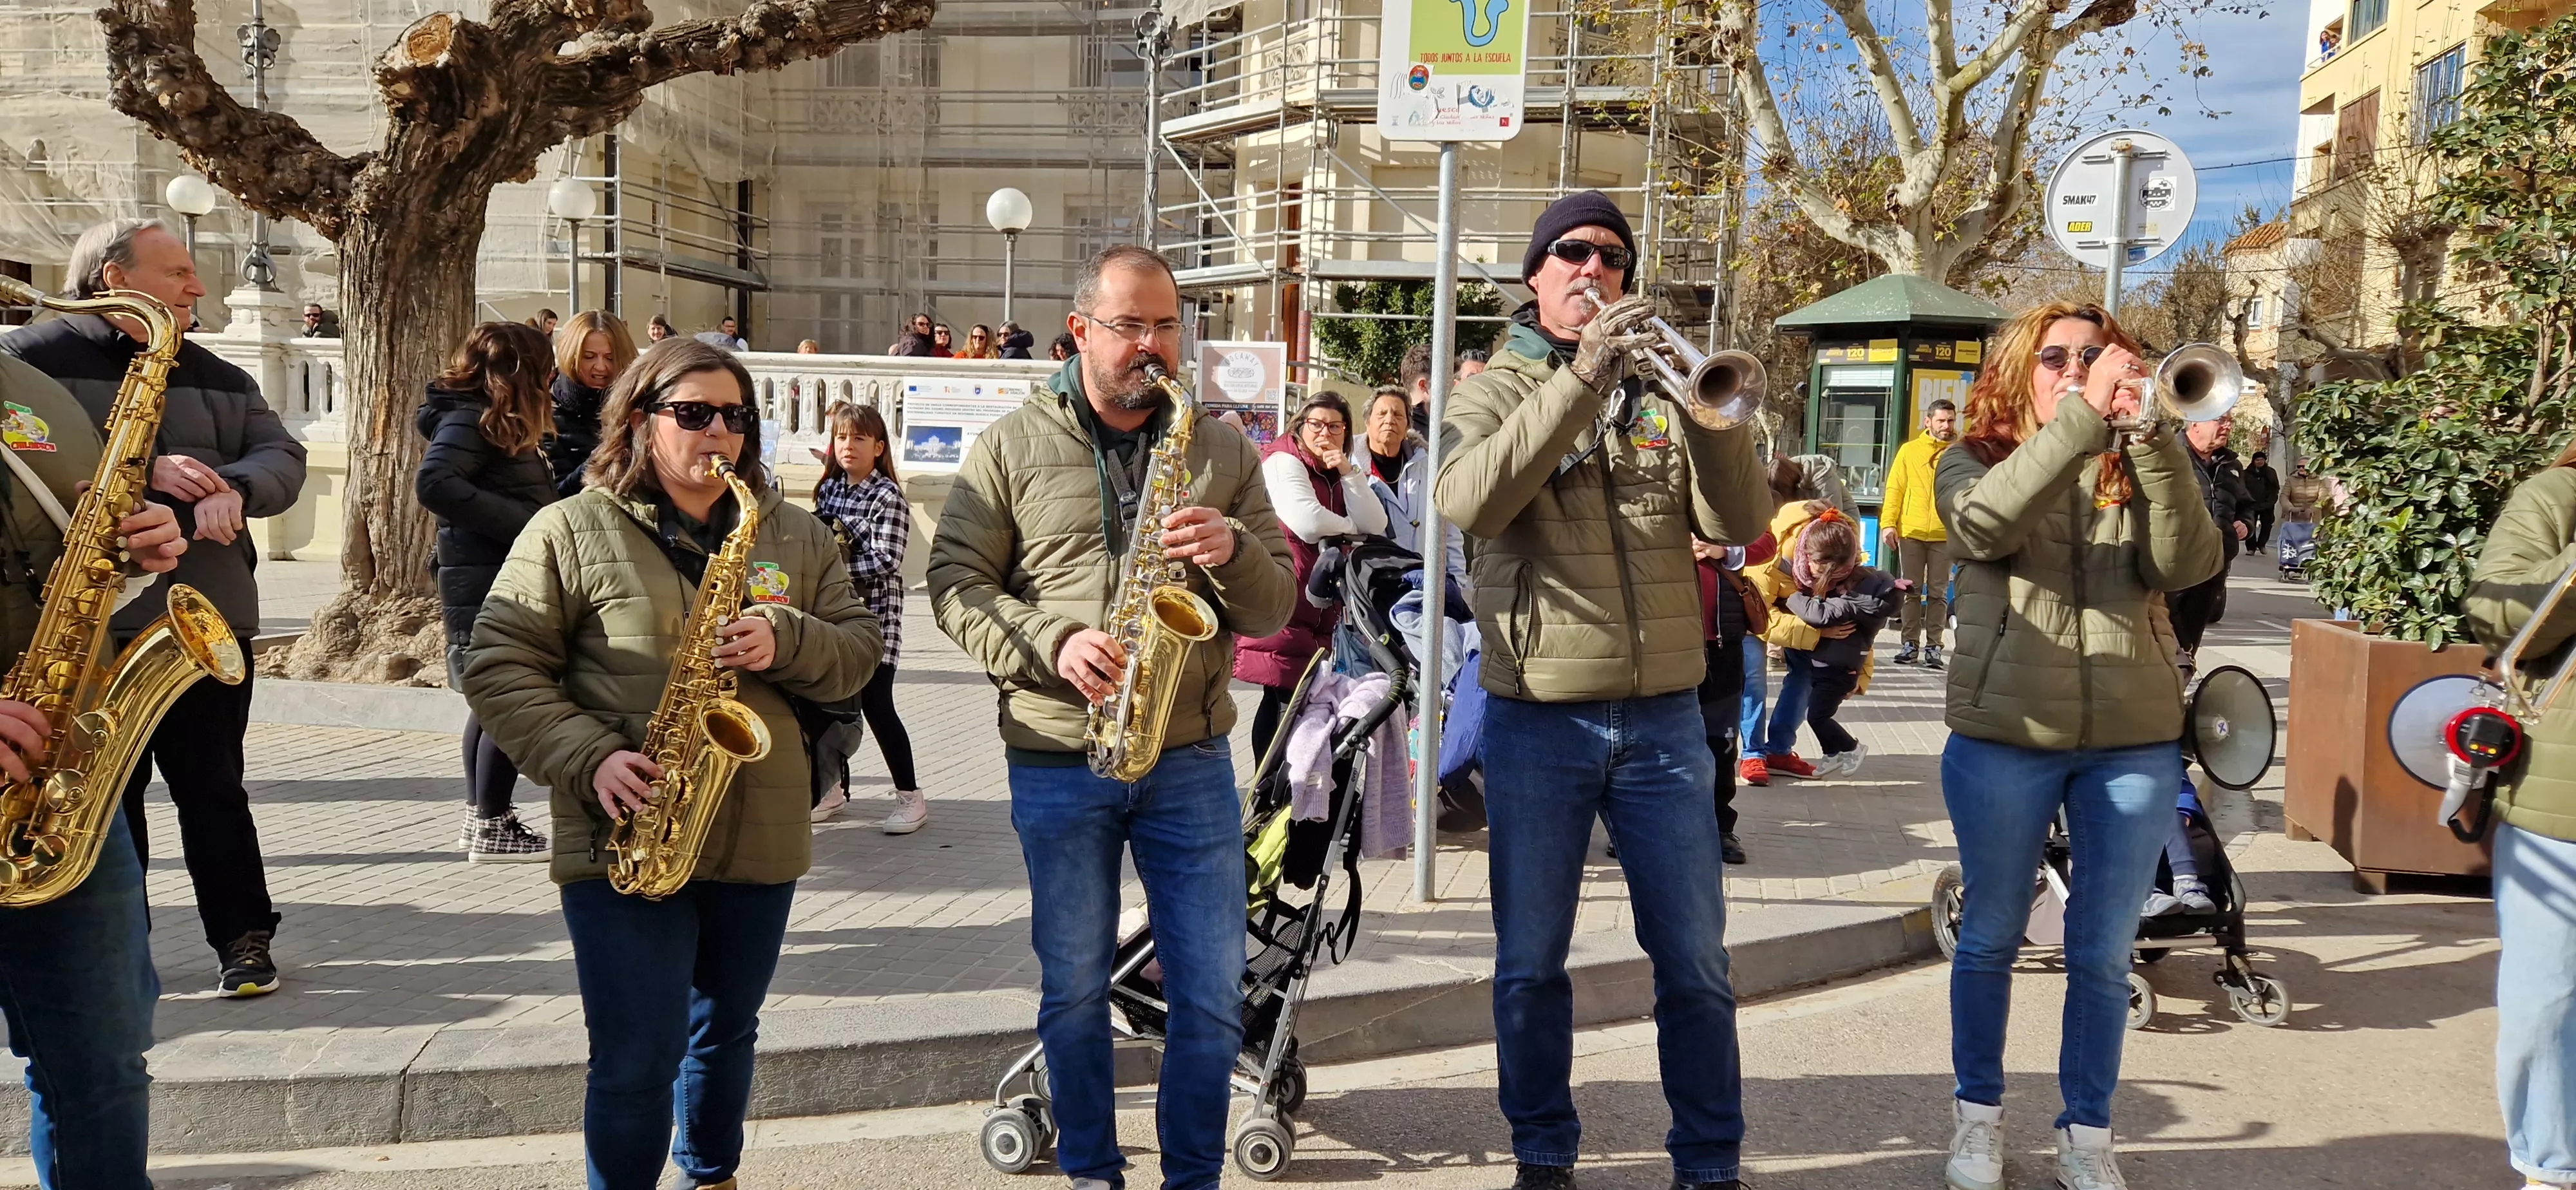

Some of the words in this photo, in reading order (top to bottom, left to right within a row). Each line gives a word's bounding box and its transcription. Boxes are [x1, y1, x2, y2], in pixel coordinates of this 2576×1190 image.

[1420, 53, 1438, 62] TODOS
[1441, 53, 1463, 62] JUNTOS
[1465, 53, 1470, 62] A
[1473, 53, 1482, 62] LA
[1485, 53, 1511, 62] ESCUELA
[2062, 194, 2097, 205] SMAK47
[2068, 222, 2092, 232] ADER
[1846, 348, 1864, 357] 120
[1935, 346, 1951, 357] 120
[1918, 378, 1967, 412] BIEN
